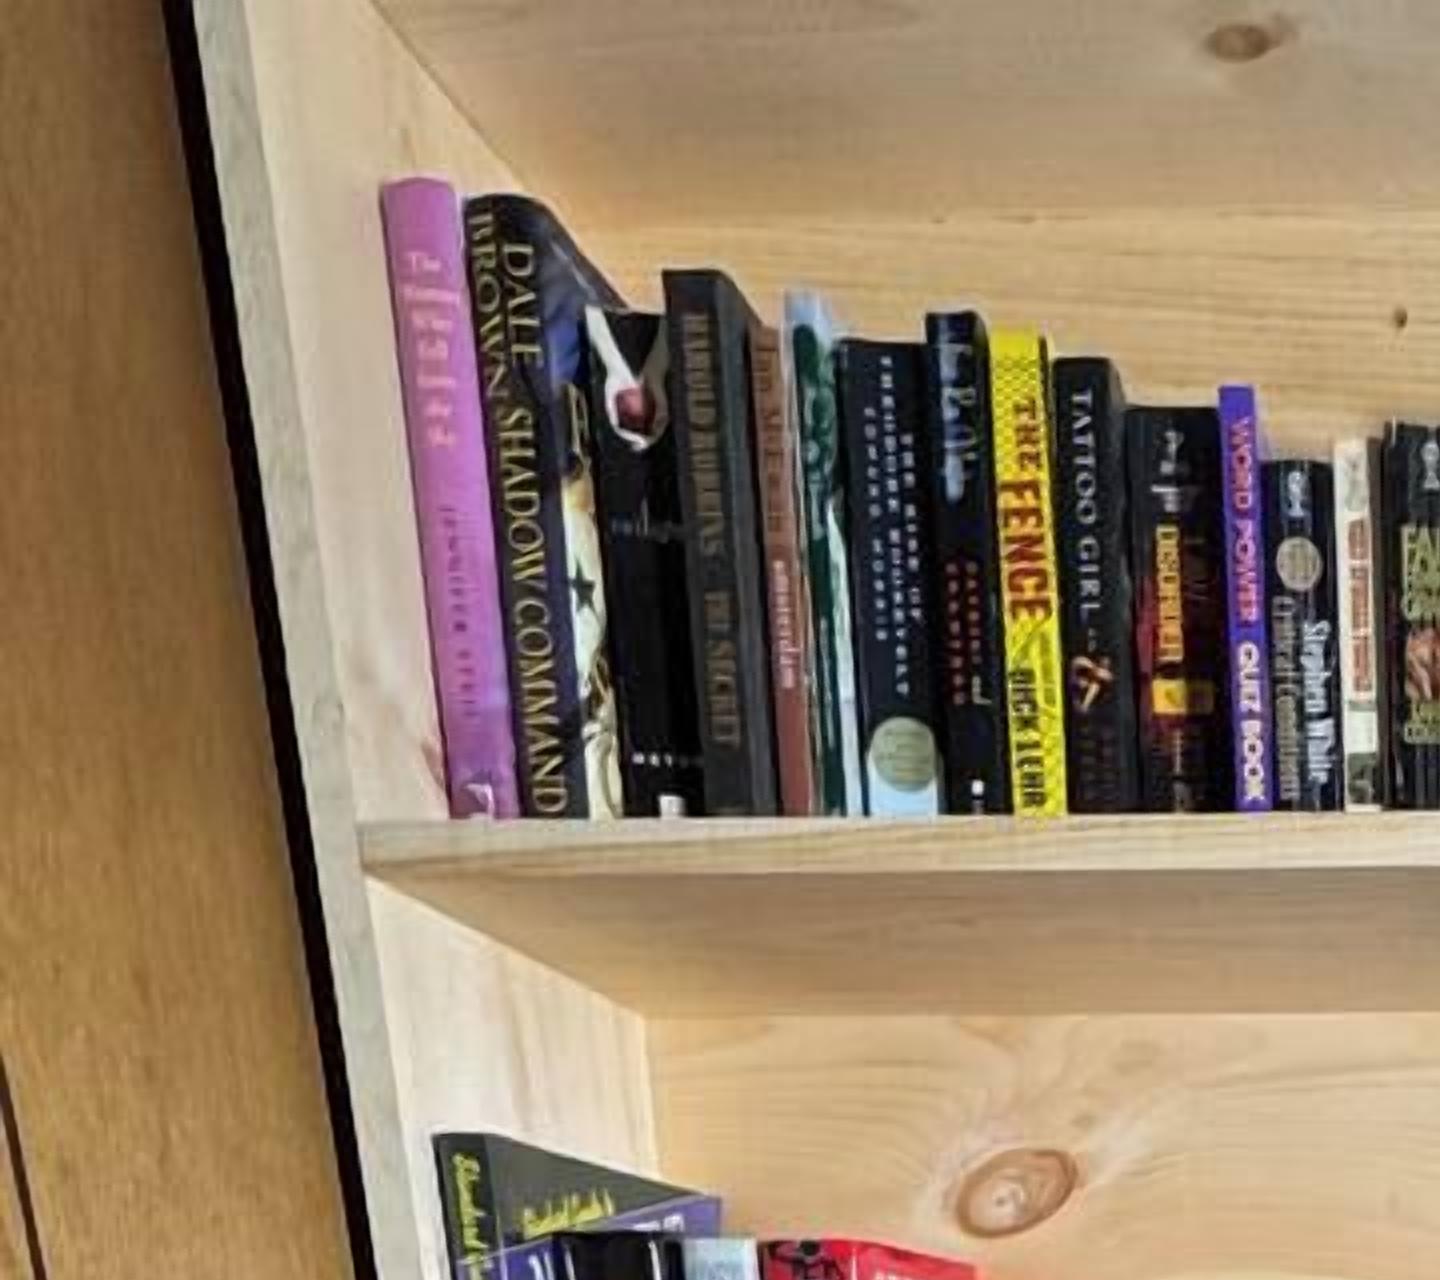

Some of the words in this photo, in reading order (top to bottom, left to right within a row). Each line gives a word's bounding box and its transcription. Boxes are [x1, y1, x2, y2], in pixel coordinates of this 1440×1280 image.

[468, 211, 508, 398] BROWN
[503, 242, 544, 368] DALE
[497, 407, 548, 588] SHADOW
[1012, 398, 1043, 473] THE
[1072, 387, 1097, 524] TATTOO
[1000, 477, 1052, 622] FENCE
[1079, 536, 1100, 618] GIRL
[513, 600, 567, 812] COMMAND
[1241, 719, 1265, 802] BOOK
